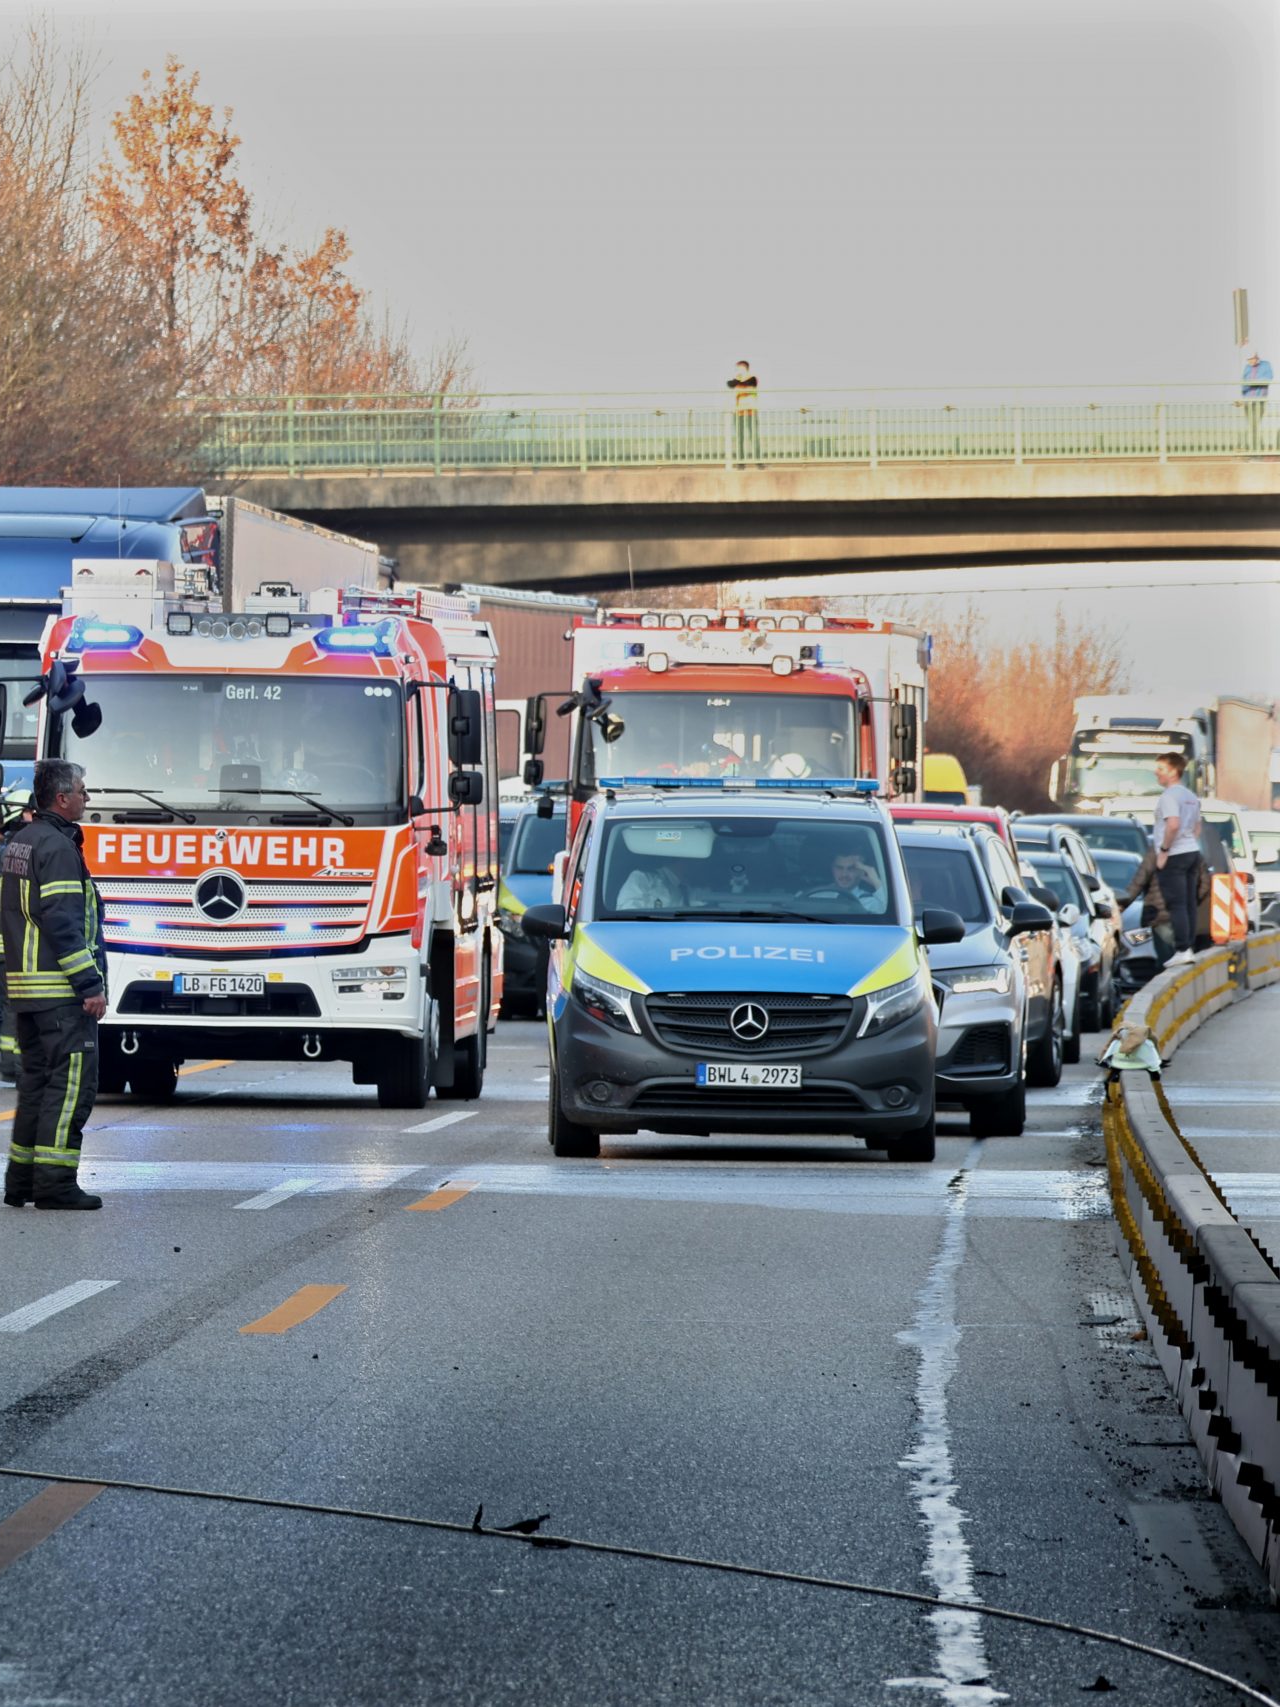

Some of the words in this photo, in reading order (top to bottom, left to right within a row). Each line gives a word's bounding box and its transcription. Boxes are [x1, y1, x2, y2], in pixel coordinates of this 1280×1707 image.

[226, 684, 259, 700] Gerl.
[264, 685, 282, 700] 42
[97, 833, 345, 867] FEUERWEHR
[671, 945, 825, 963] POLIZEI
[183, 978, 200, 991] LB
[210, 978, 226, 992] FG
[230, 979, 262, 992] 1420
[708, 1067, 736, 1083] BWL
[741, 1069, 749, 1084] 4
[761, 1068, 798, 1084] 2973
